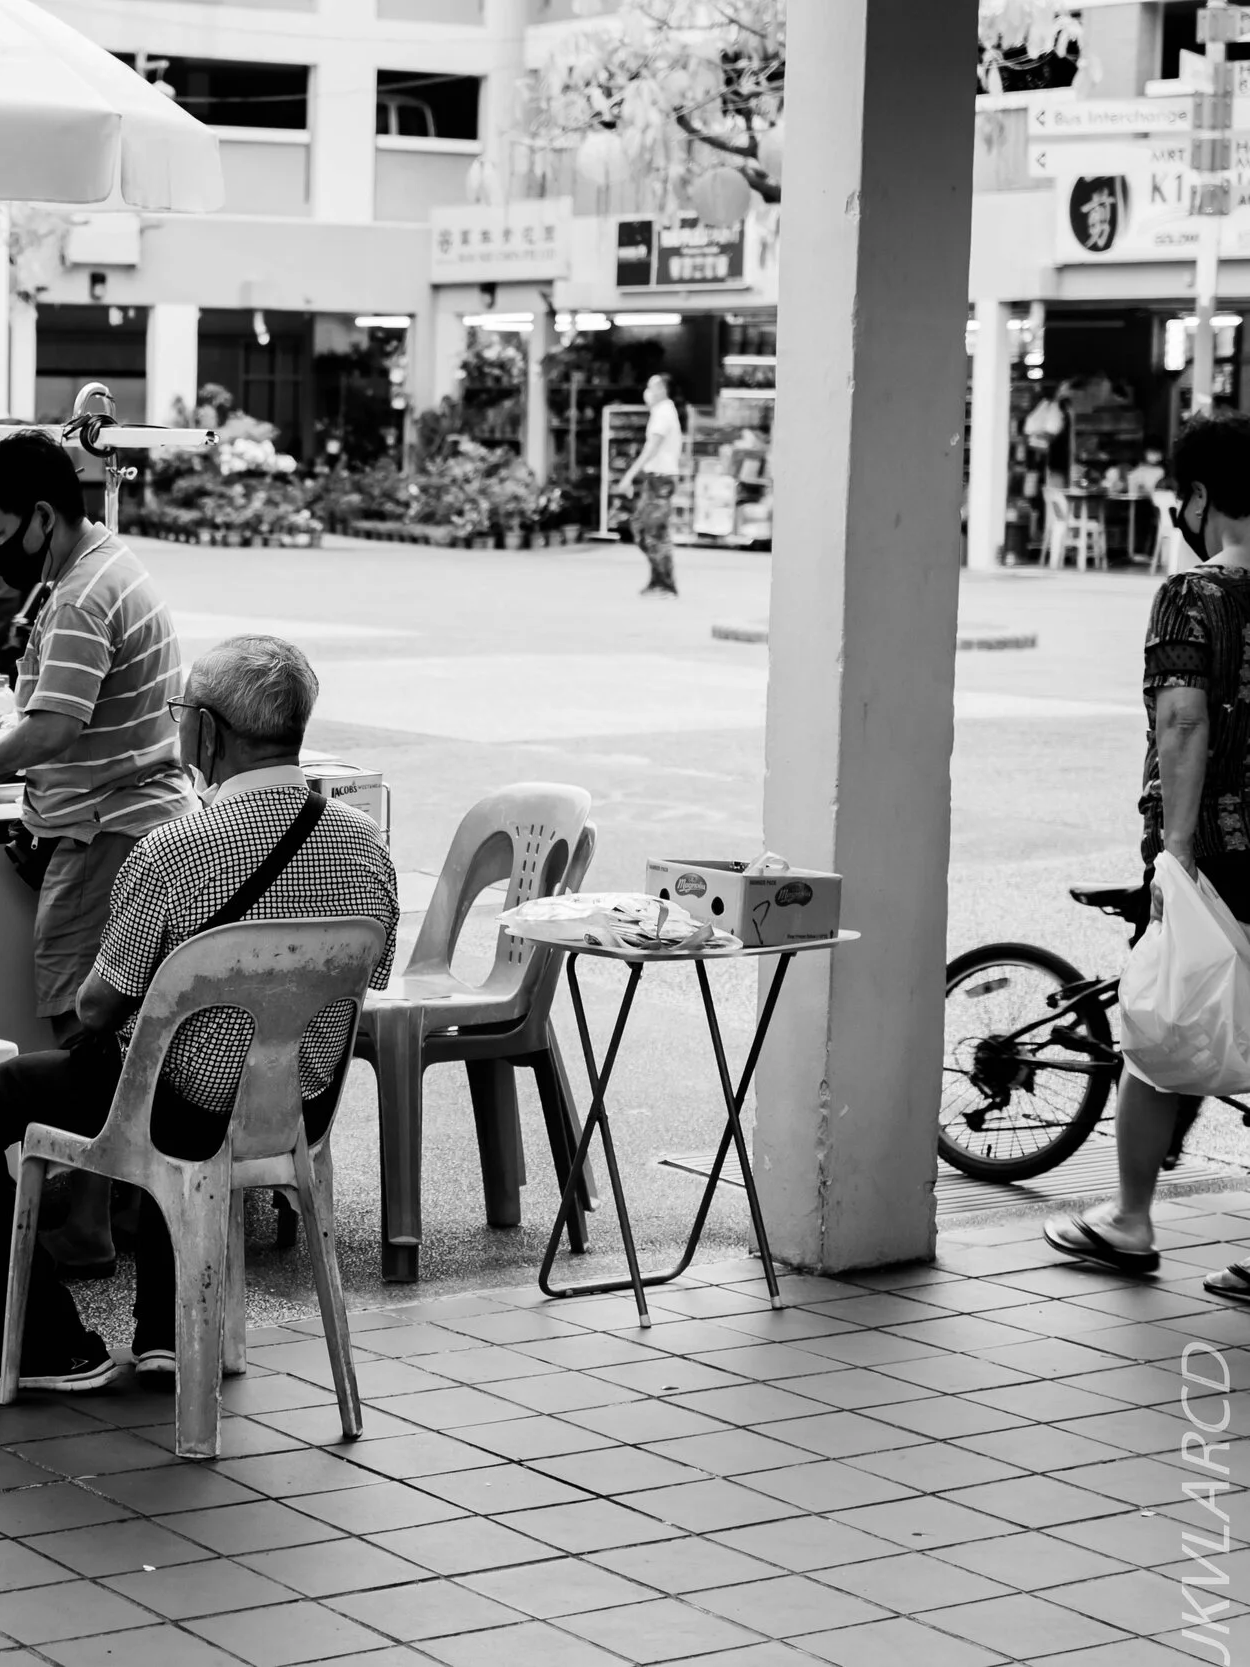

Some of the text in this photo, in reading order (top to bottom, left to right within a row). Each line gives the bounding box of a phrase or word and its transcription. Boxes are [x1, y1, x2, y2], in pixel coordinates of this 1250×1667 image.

[1054, 109, 1188, 126] Bus Interchange
[1151, 148, 1186, 163] MRT
